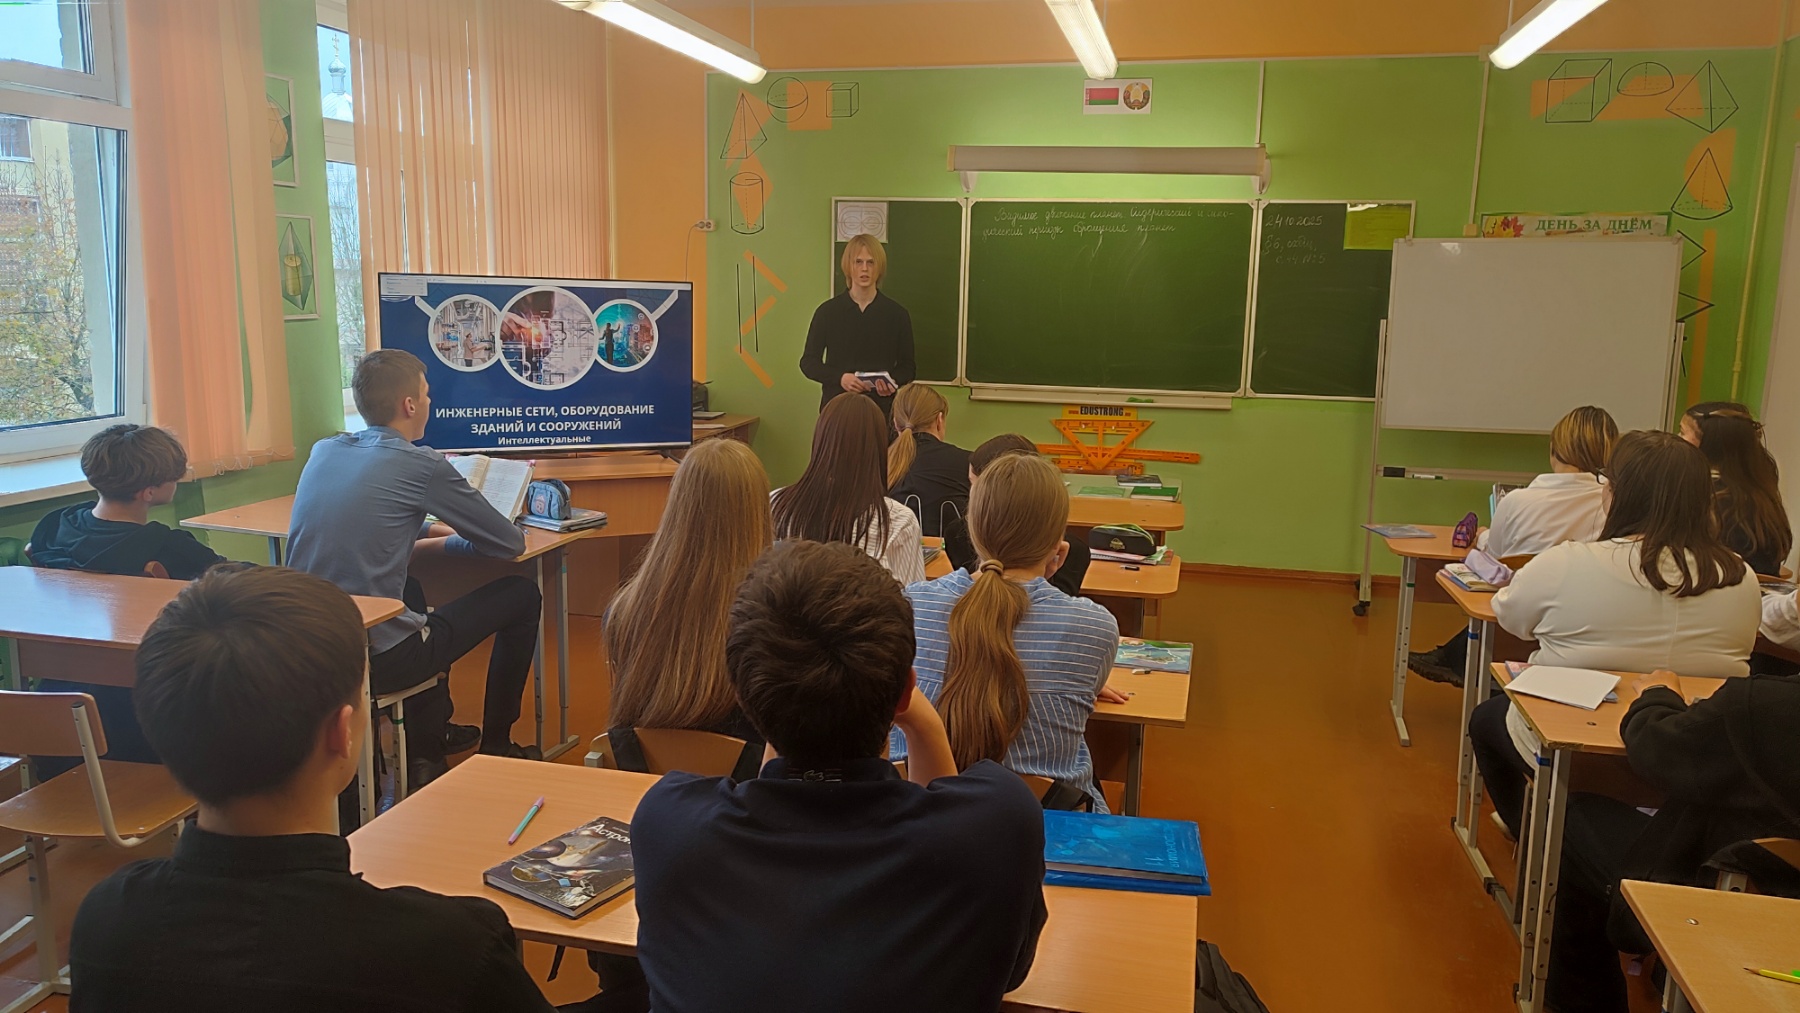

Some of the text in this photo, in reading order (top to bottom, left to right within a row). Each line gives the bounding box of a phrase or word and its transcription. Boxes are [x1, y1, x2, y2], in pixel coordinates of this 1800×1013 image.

[1535, 217, 1652, 231] ДЕНЬ ЗА ДНЁМ
[435, 404, 655, 419] ИНЖЕНЕРНЫЕ СЕТИ, ОБОРУДОВАНИЕ
[1080, 405, 1124, 417] EDUSTRONG
[471, 418, 622, 436] ЗДАНИЙ И СООРУЖЕНИЙ
[497, 435, 592, 446] Интеллектуальные
